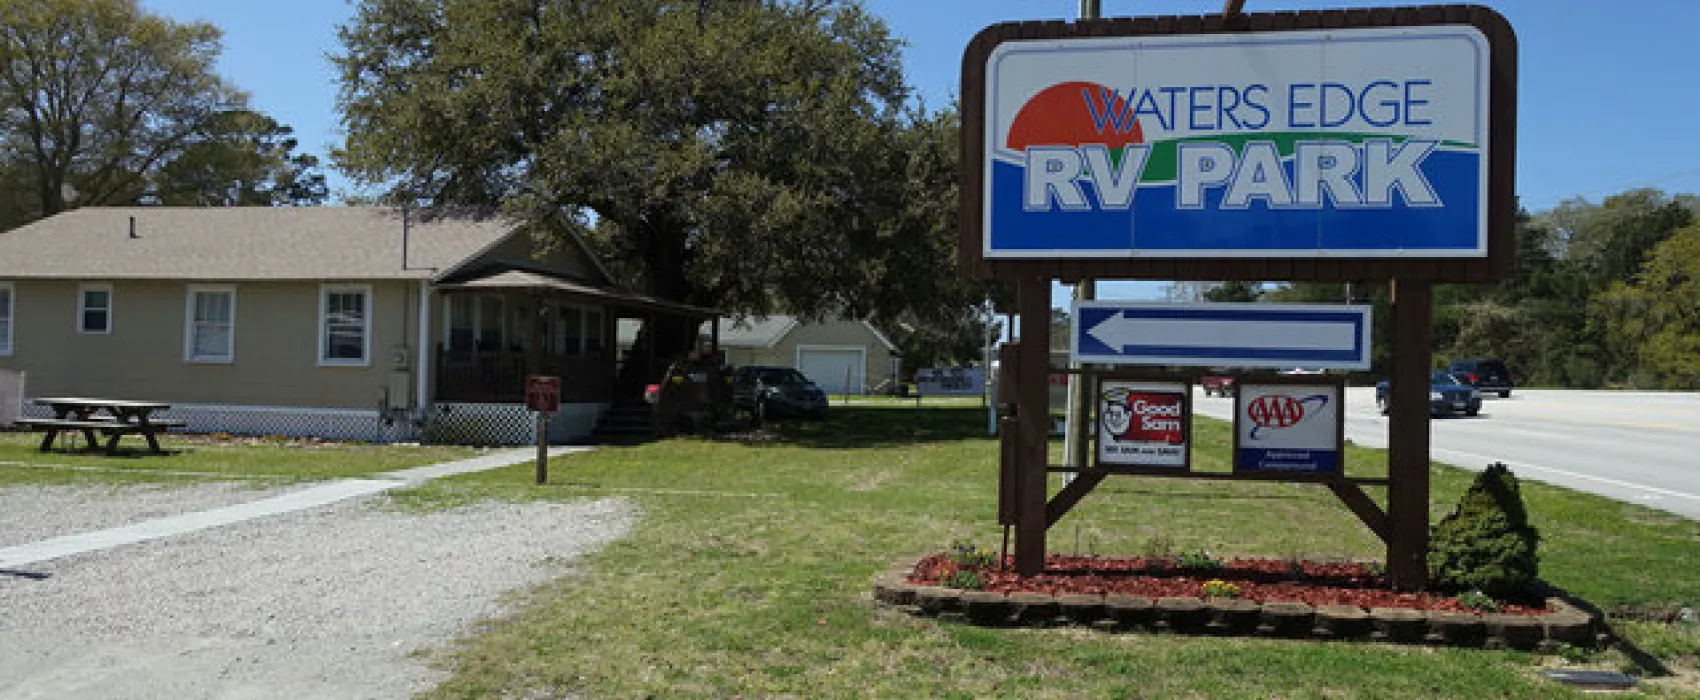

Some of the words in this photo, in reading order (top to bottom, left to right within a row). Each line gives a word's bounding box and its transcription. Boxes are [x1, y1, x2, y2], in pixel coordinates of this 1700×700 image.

[1083, 84, 1270, 133] WATERS
[1288, 79, 1431, 128] EDGE
[1023, 143, 1151, 211] RV
[1176, 140, 1444, 209] PARK
[1133, 399, 1181, 416] Good
[1141, 415, 1181, 431] Sam
[1249, 395, 1304, 427] AAA
